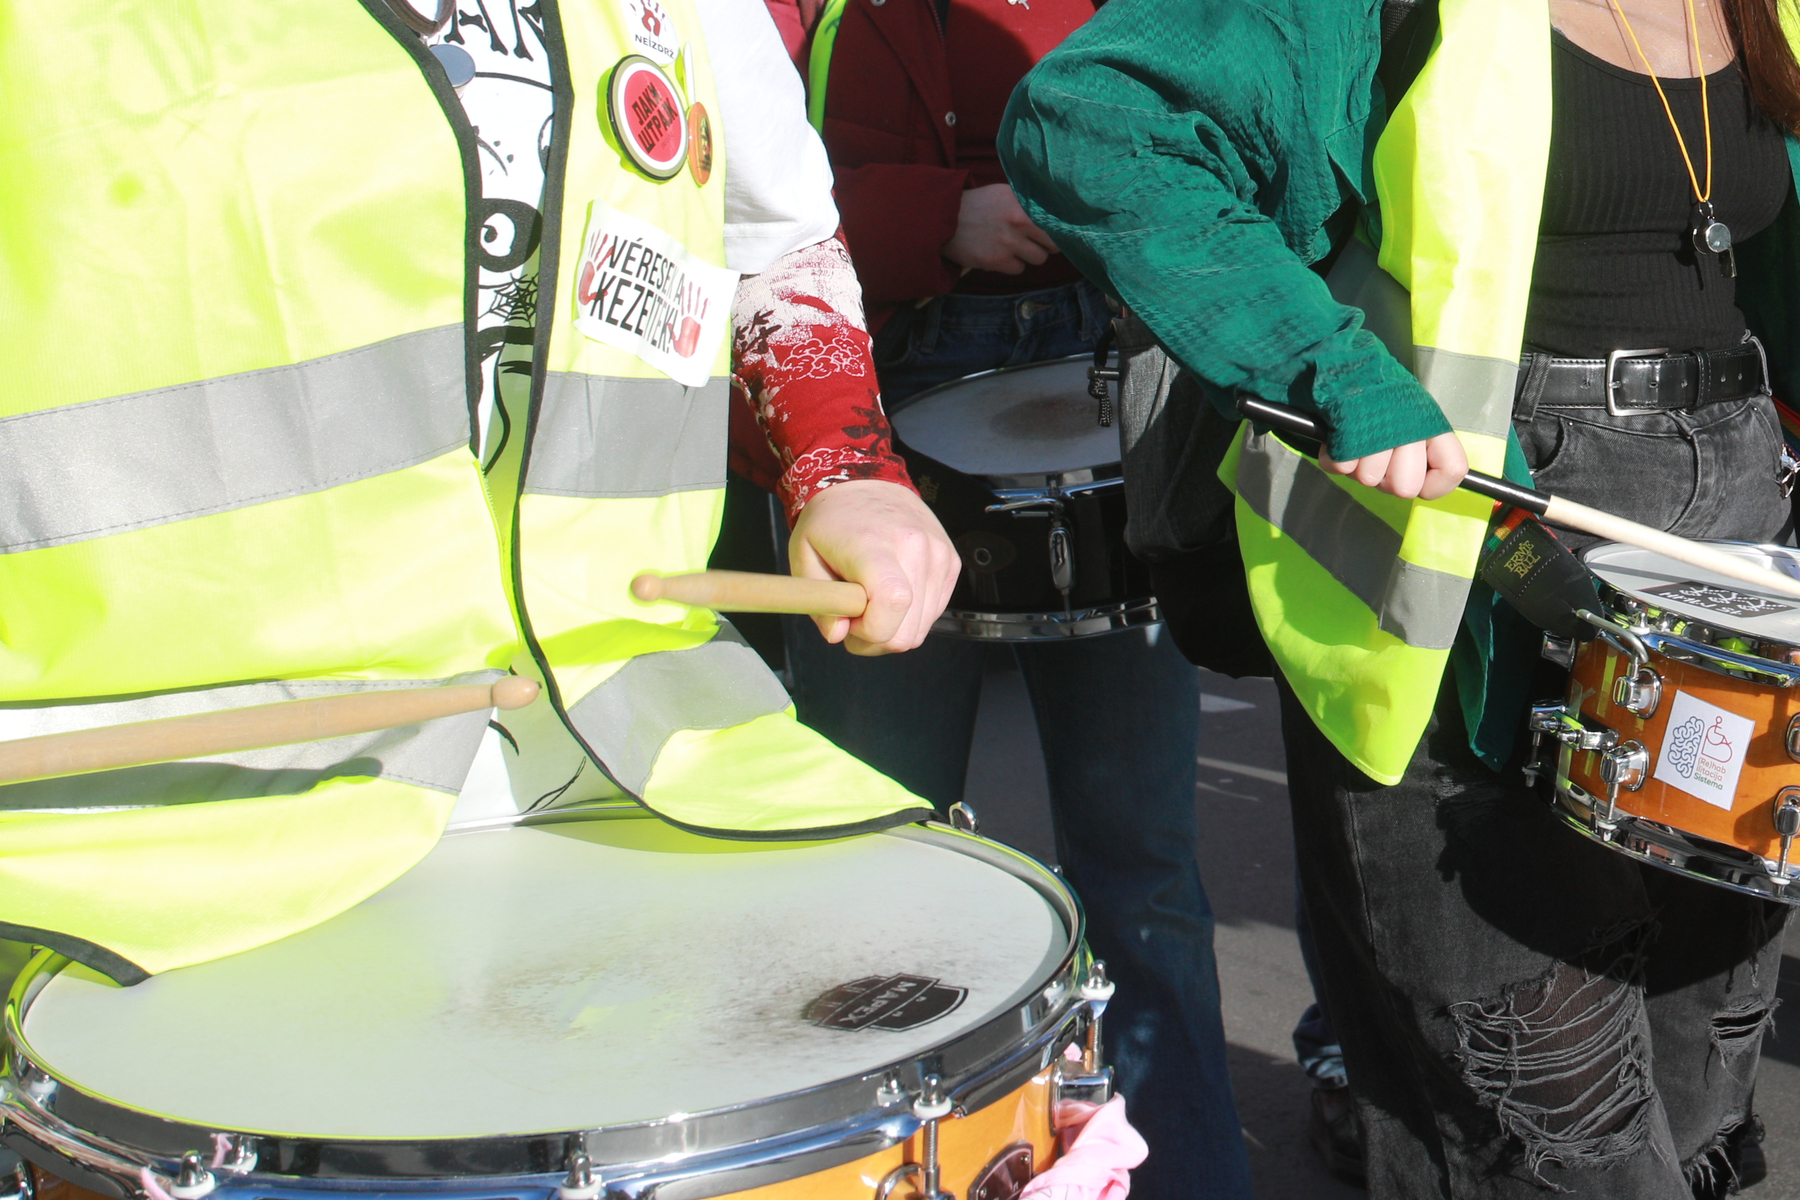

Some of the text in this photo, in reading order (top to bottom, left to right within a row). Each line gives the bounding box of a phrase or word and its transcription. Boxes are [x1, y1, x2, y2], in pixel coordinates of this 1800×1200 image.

[637, 97, 679, 155] ШТРАЈК
[609, 235, 685, 306] VÉRESEK A
[1504, 539, 1535, 572] ERNIE
[1514, 554, 1541, 579] BALL
[1695, 765, 1723, 782] ilitacija
[1697, 756, 1727, 774] (Re)hab
[1693, 772, 1724, 790] Sistema
[838, 980, 917, 1024] MAPEX
